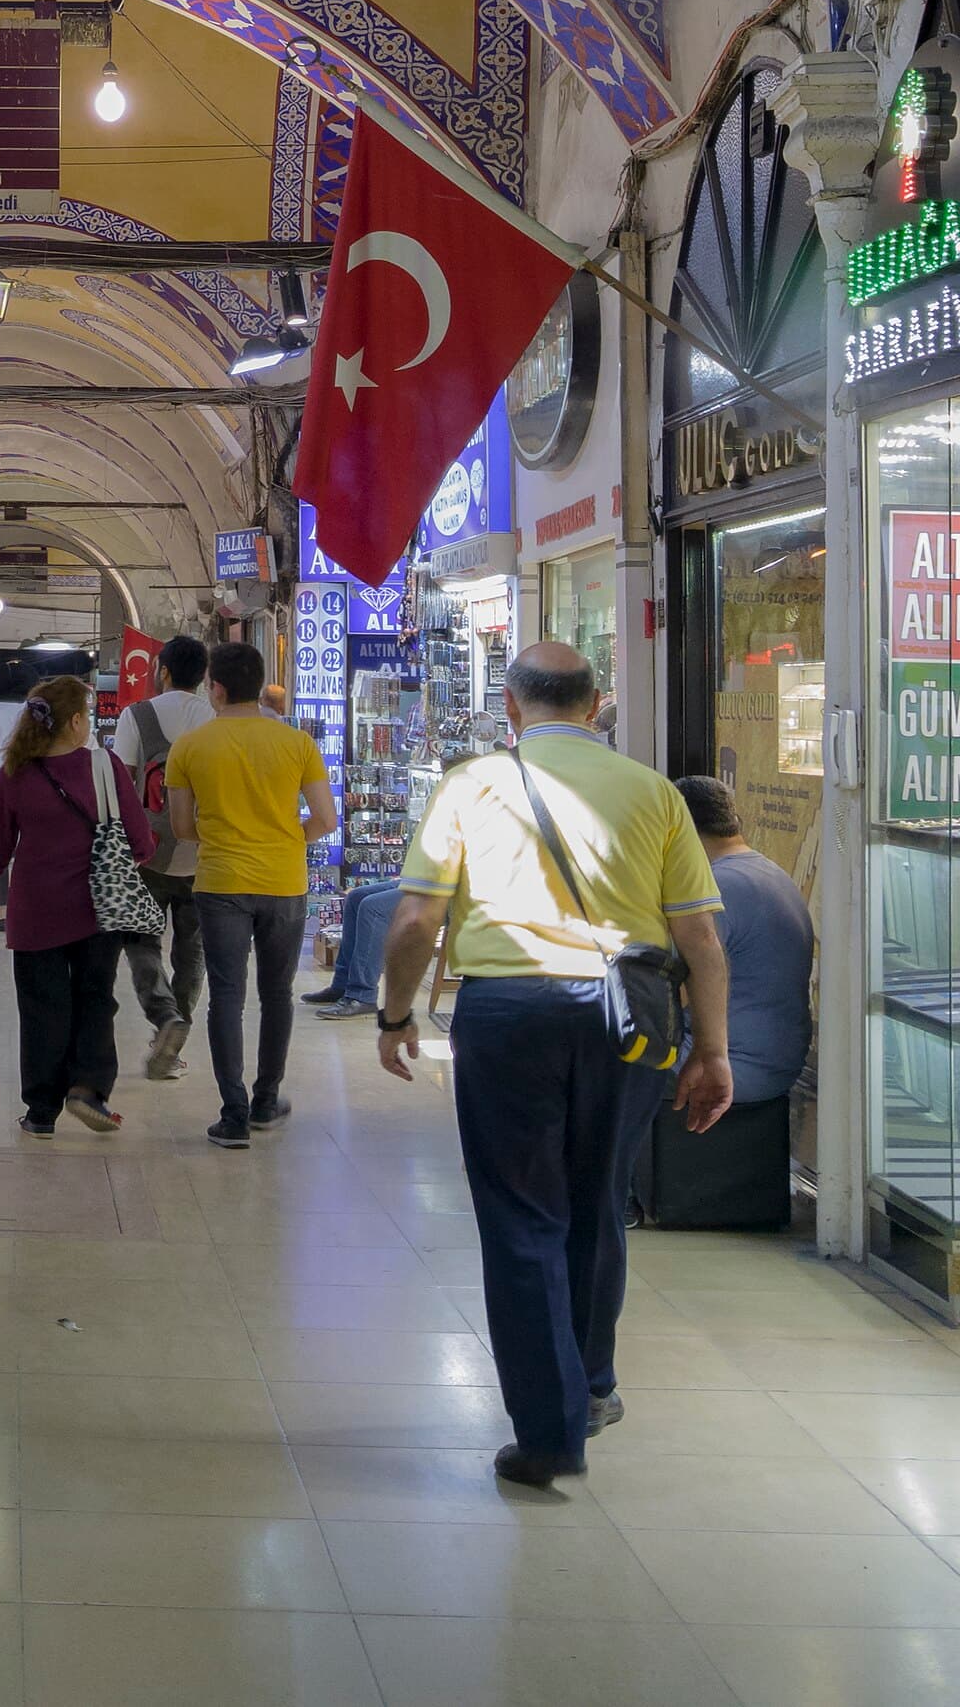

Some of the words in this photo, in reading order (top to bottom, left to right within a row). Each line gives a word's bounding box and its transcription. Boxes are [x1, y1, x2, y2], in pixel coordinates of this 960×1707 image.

[744, 424, 795, 477] GOLD
[300, 594, 314, 612] 14
[326, 595, 341, 612] 14
[300, 622, 314, 640] 18
[326, 623, 340, 641] 18
[300, 650, 314, 668] 22
[325, 651, 340, 669] 22
[296, 675, 316, 694] AYAR
[321, 676, 343, 695] AYAR
[320, 705, 344, 724] ALTIN
